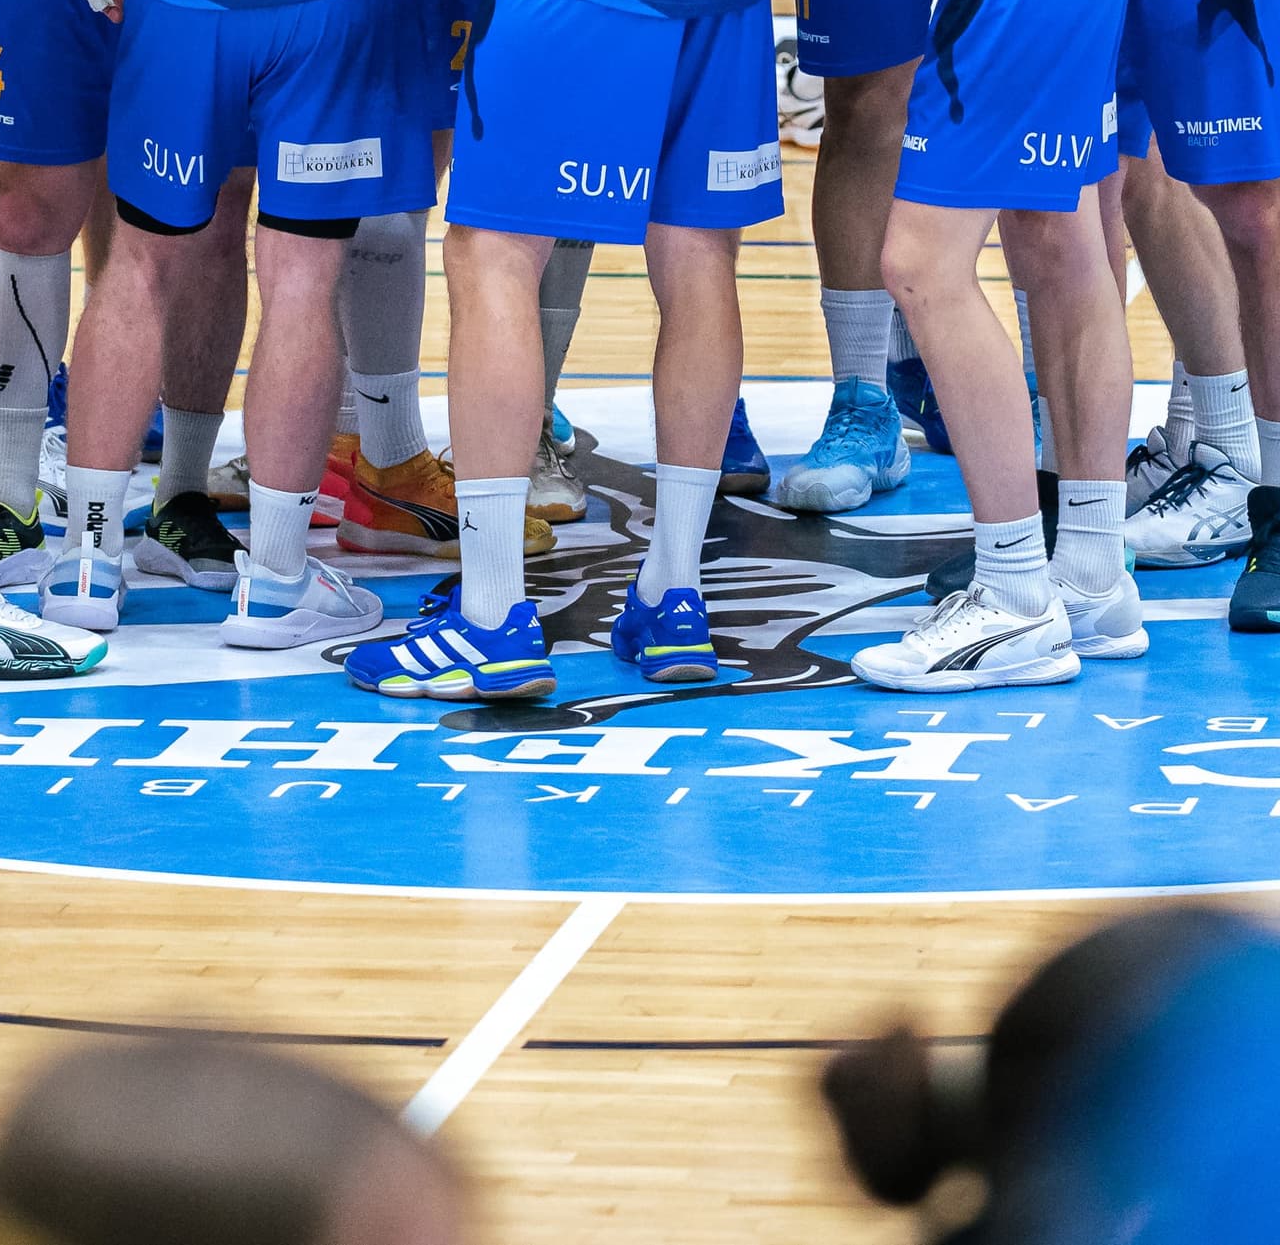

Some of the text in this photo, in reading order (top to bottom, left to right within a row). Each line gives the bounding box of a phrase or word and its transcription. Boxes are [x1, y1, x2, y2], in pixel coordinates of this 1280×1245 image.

[1186, 116, 1263, 136] MULTIMEK
[901, 134, 929, 153] TIMEK
[1019, 131, 1094, 169] SU.VI
[1187, 135, 1220, 148] BALTIC
[142, 137, 204, 187] SU.VI
[305, 156, 375, 174] KODUAKEN
[556, 160, 651, 201] SU.VI
[85, 500, 106, 548] mpa
